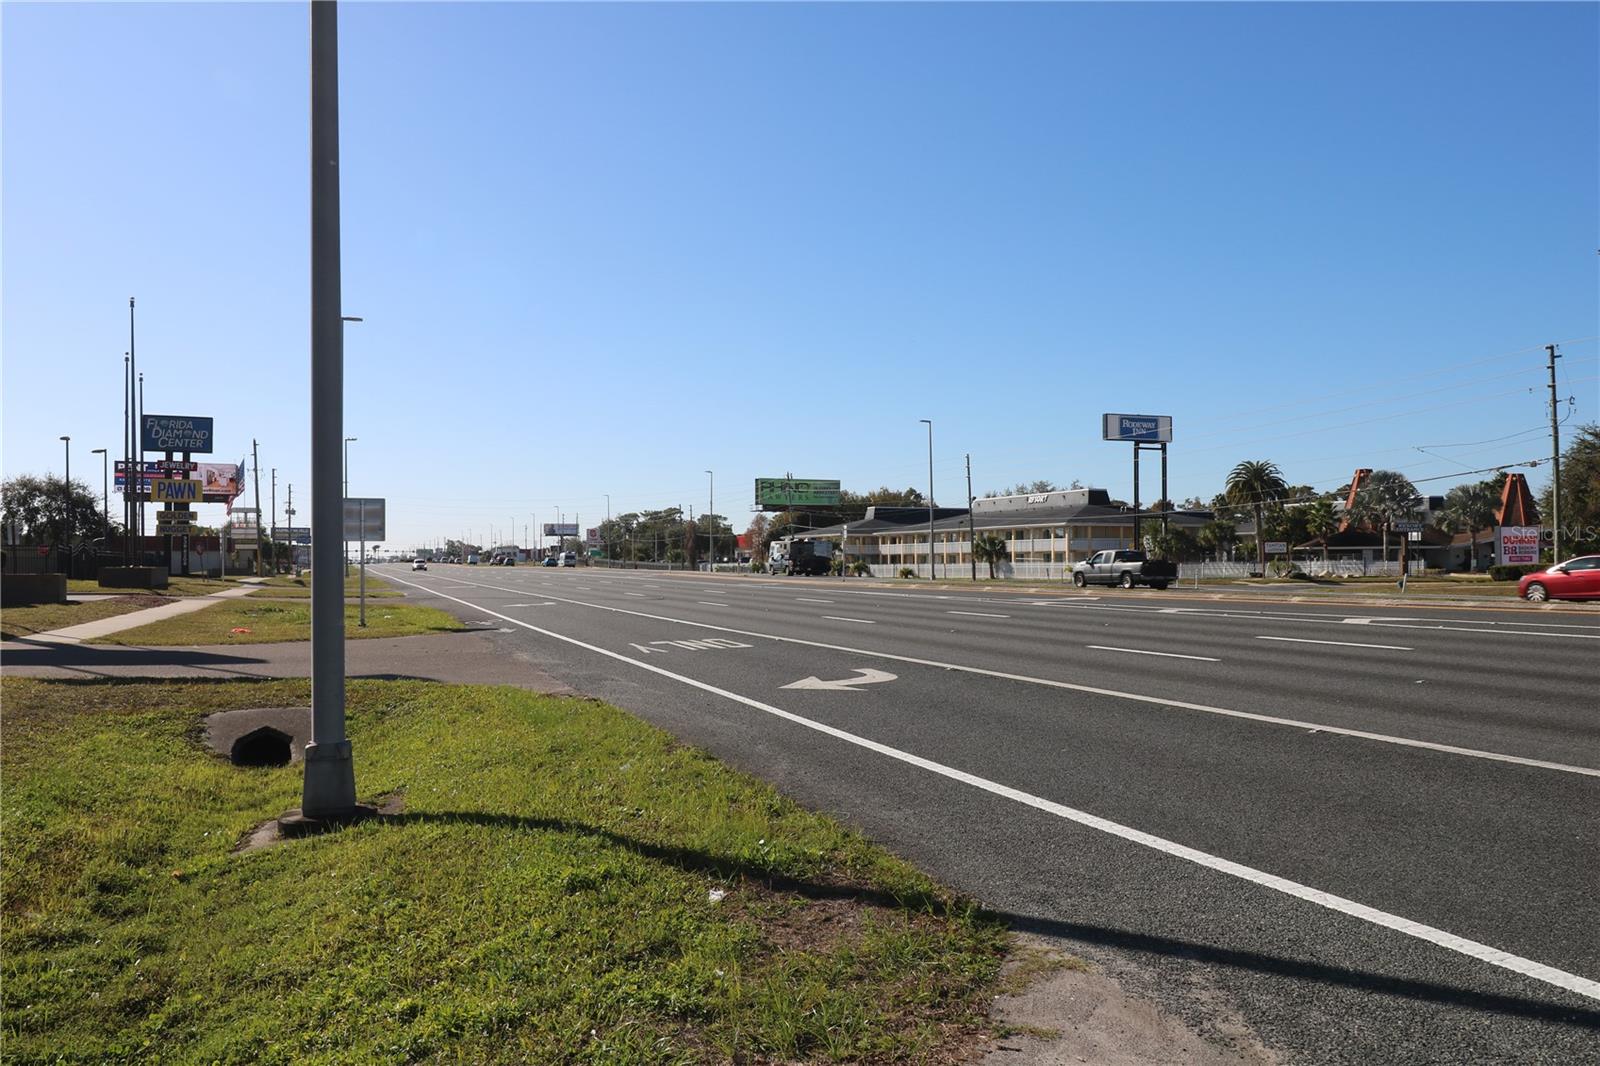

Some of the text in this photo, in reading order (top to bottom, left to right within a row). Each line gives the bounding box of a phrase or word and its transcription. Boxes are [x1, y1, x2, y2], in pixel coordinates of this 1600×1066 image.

[151, 427, 209, 440] DIAMOND
[158, 437, 204, 449] CENTER
[159, 461, 196, 471] JEWELRY
[157, 482, 196, 500] PAWN
[160, 511, 195, 520] GOLDEN
[160, 525, 192, 533] NUGGET
[628, 638, 754, 653] ONLY
